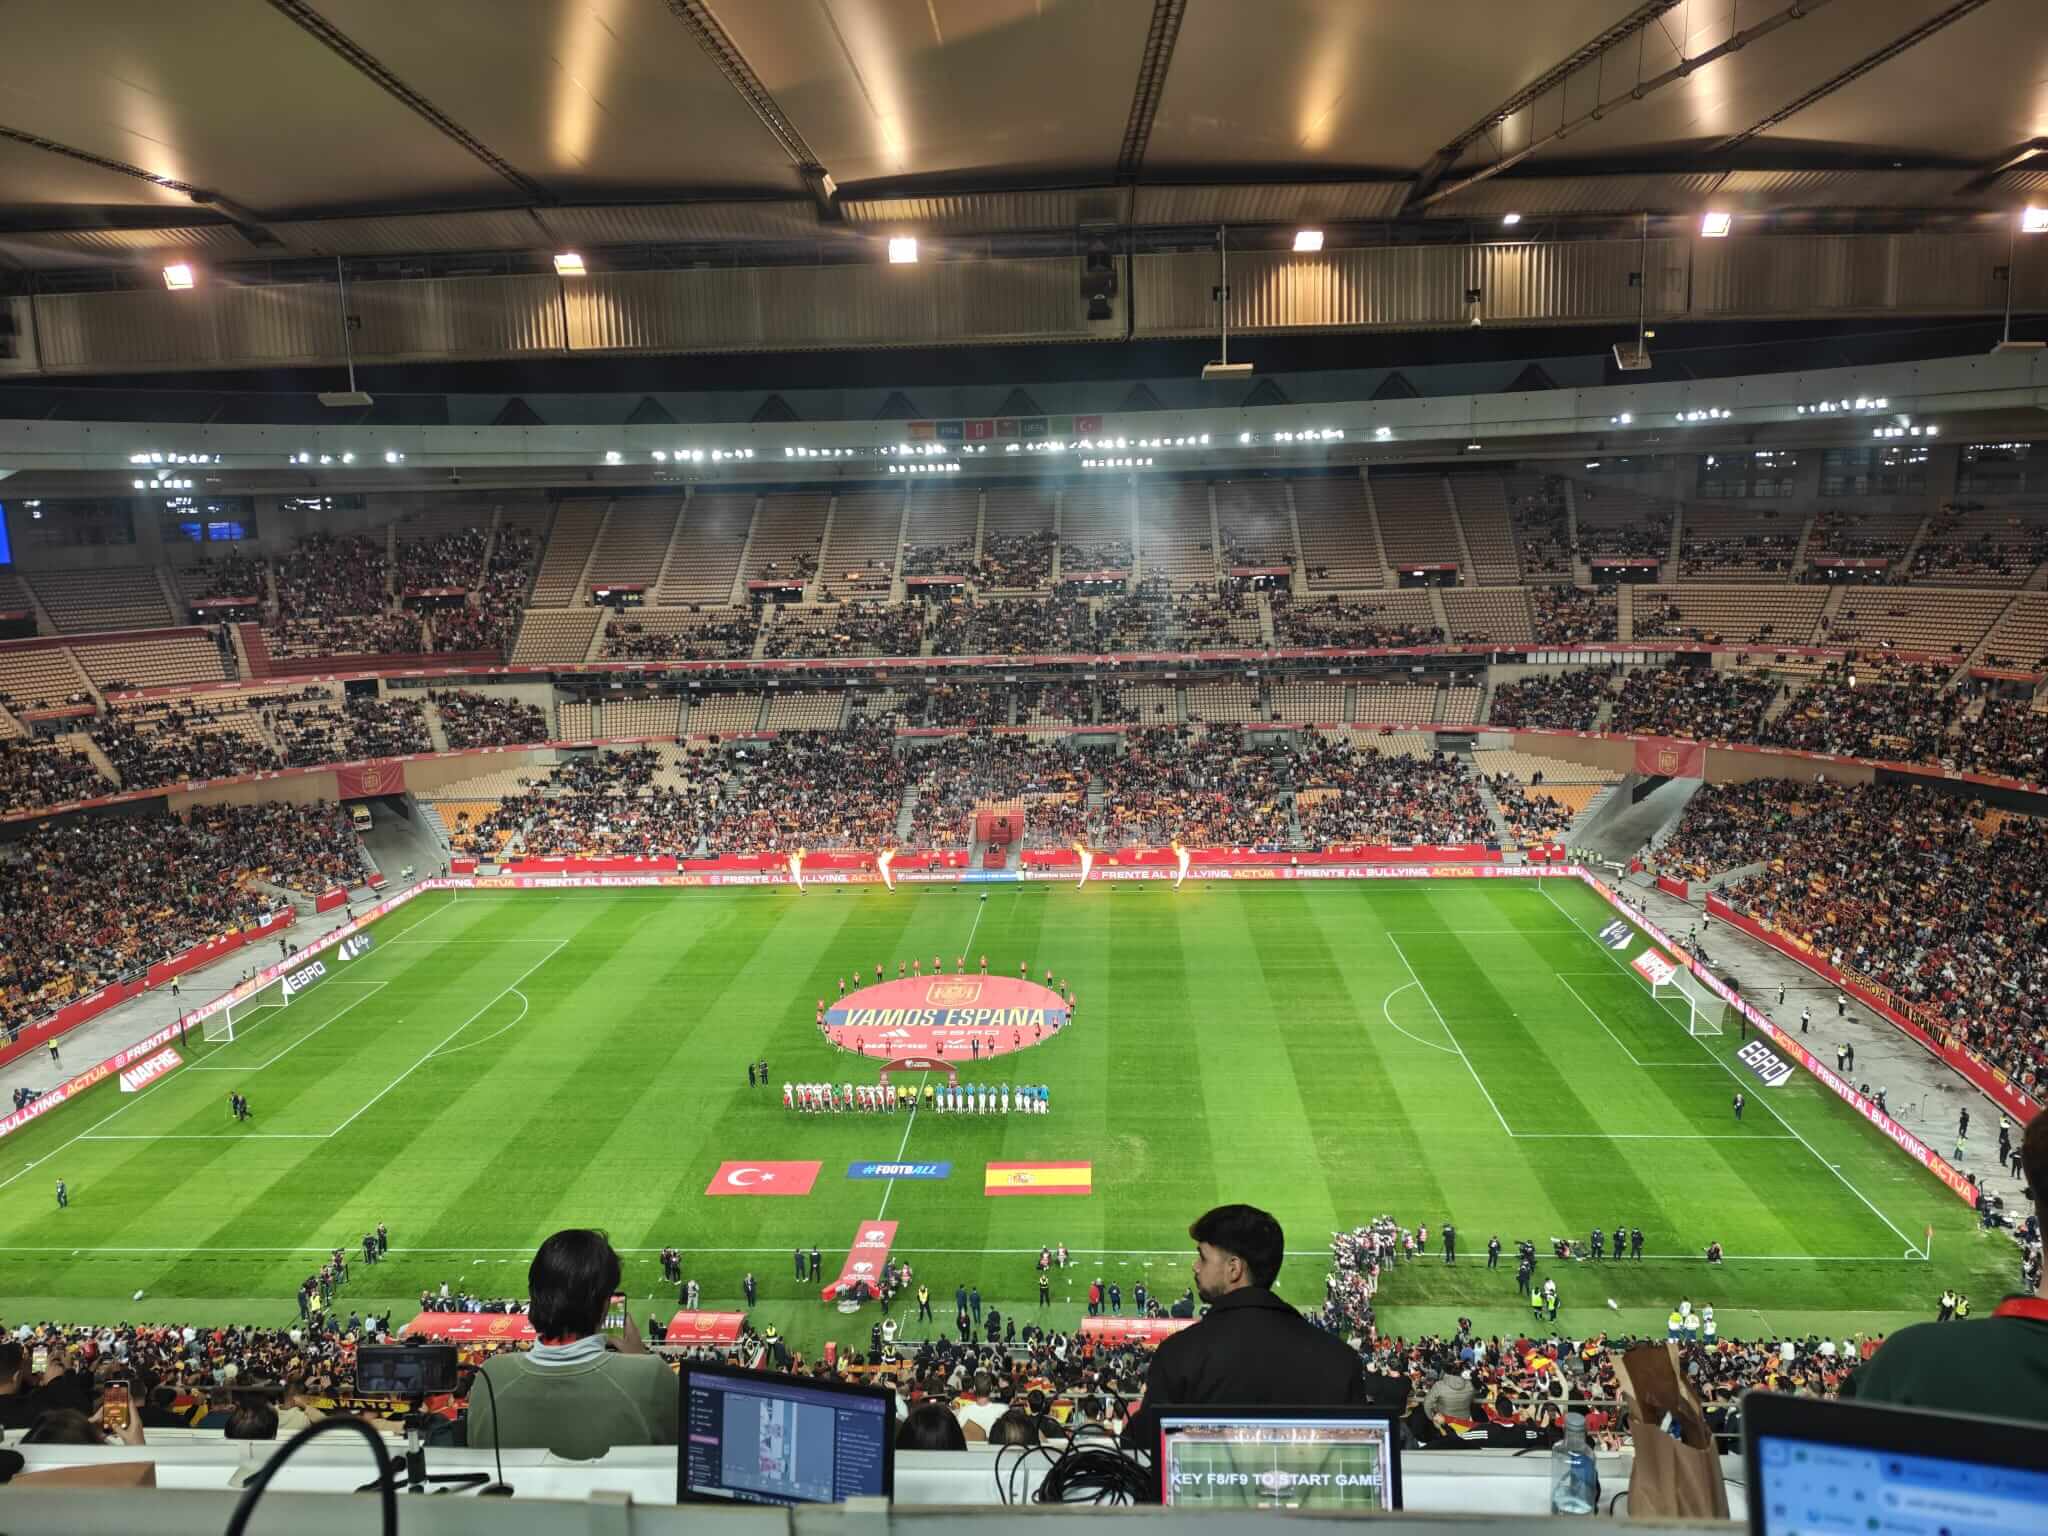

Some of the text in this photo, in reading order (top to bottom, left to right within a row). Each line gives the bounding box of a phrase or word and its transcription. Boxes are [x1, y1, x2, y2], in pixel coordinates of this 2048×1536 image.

[844, 1008, 937, 1027] VAMOS
[1171, 1473, 1384, 1487] KEY F8/F9 TO START GAME
